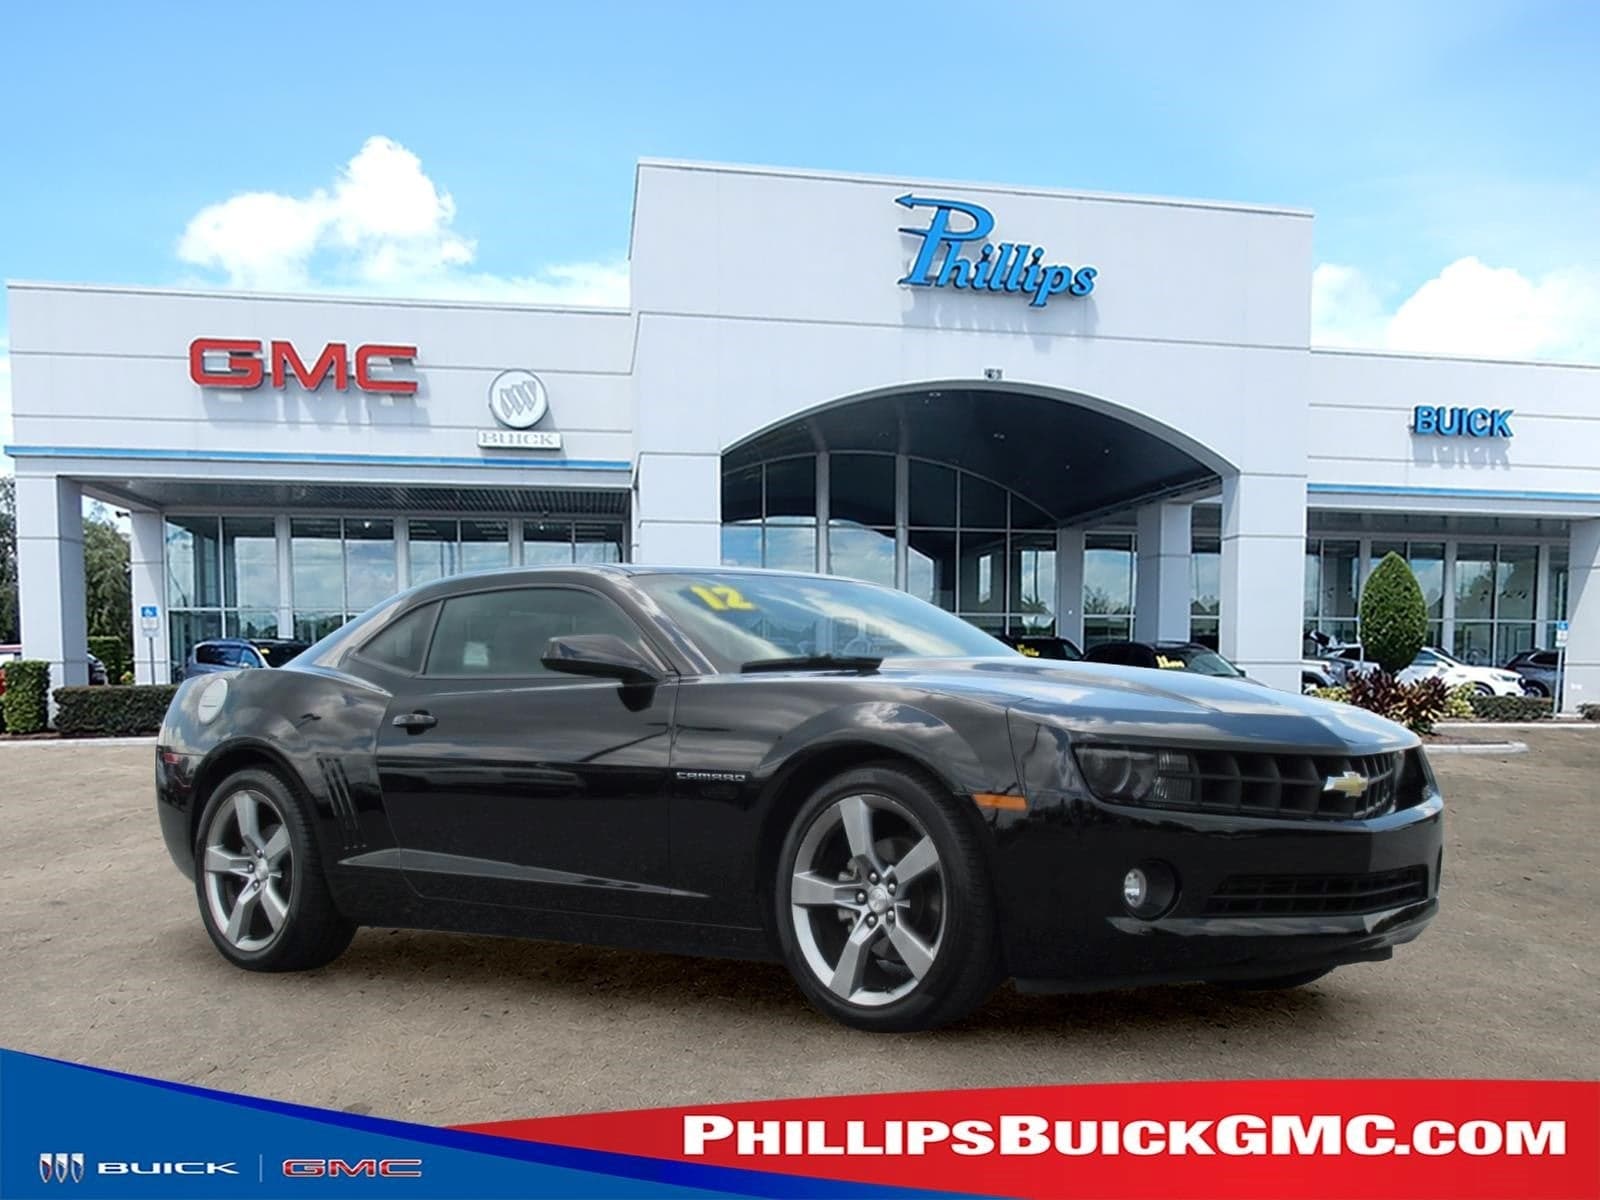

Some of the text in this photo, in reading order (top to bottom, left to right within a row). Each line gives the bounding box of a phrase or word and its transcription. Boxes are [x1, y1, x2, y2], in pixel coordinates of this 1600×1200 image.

[894, 193, 1098, 307] Phillips
[190, 337, 418, 394] GMC
[1414, 405, 1514, 438] BUICK
[482, 432, 554, 445] BUICK
[689, 584, 755, 611] 12
